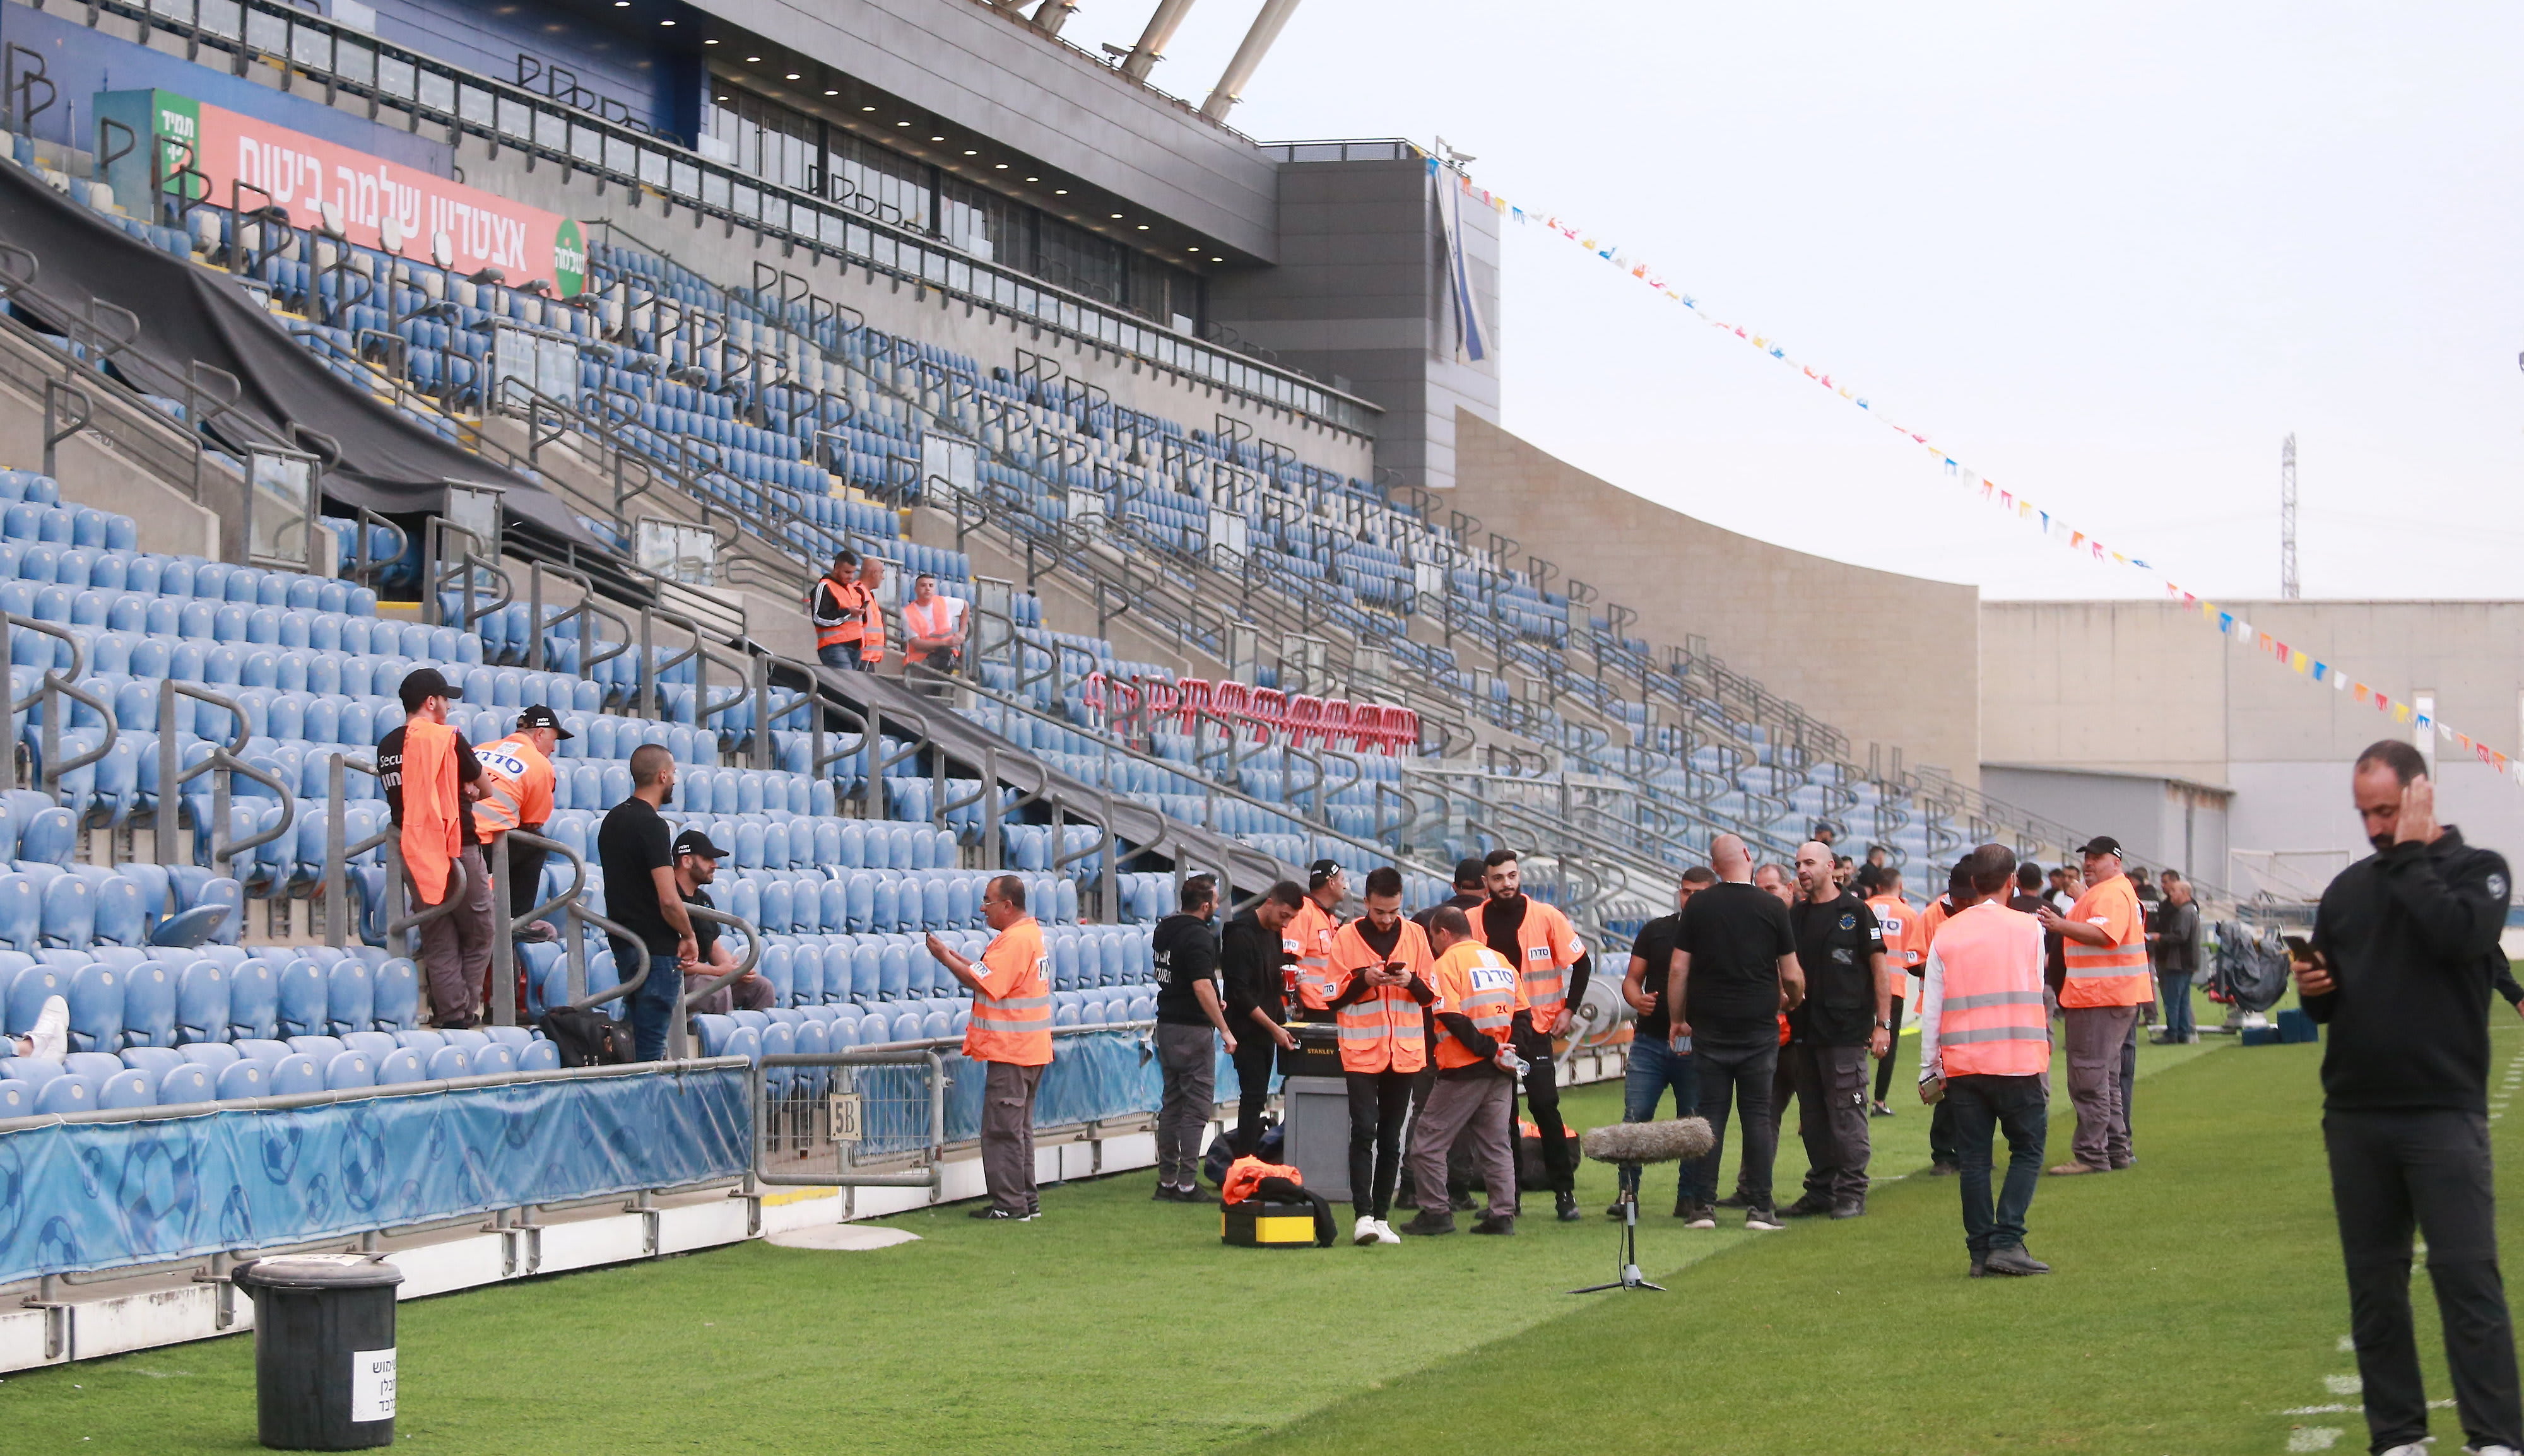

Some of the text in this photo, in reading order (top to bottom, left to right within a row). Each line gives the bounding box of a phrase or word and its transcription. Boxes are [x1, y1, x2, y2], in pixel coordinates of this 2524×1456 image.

[162, 109, 194, 138] תמיד
[239, 136, 527, 272] אצטדיון שלמה ביטוח
[555, 246, 585, 275] שלמה
[380, 754, 403, 768] Secu
[474, 751, 524, 773] סדר
[381, 772, 403, 790] חון
[1877, 920, 1899, 931] סד
[1530, 948, 1549, 959] סדרן
[1472, 970, 1514, 989] סדרן
[835, 1101, 855, 1134] 5B
